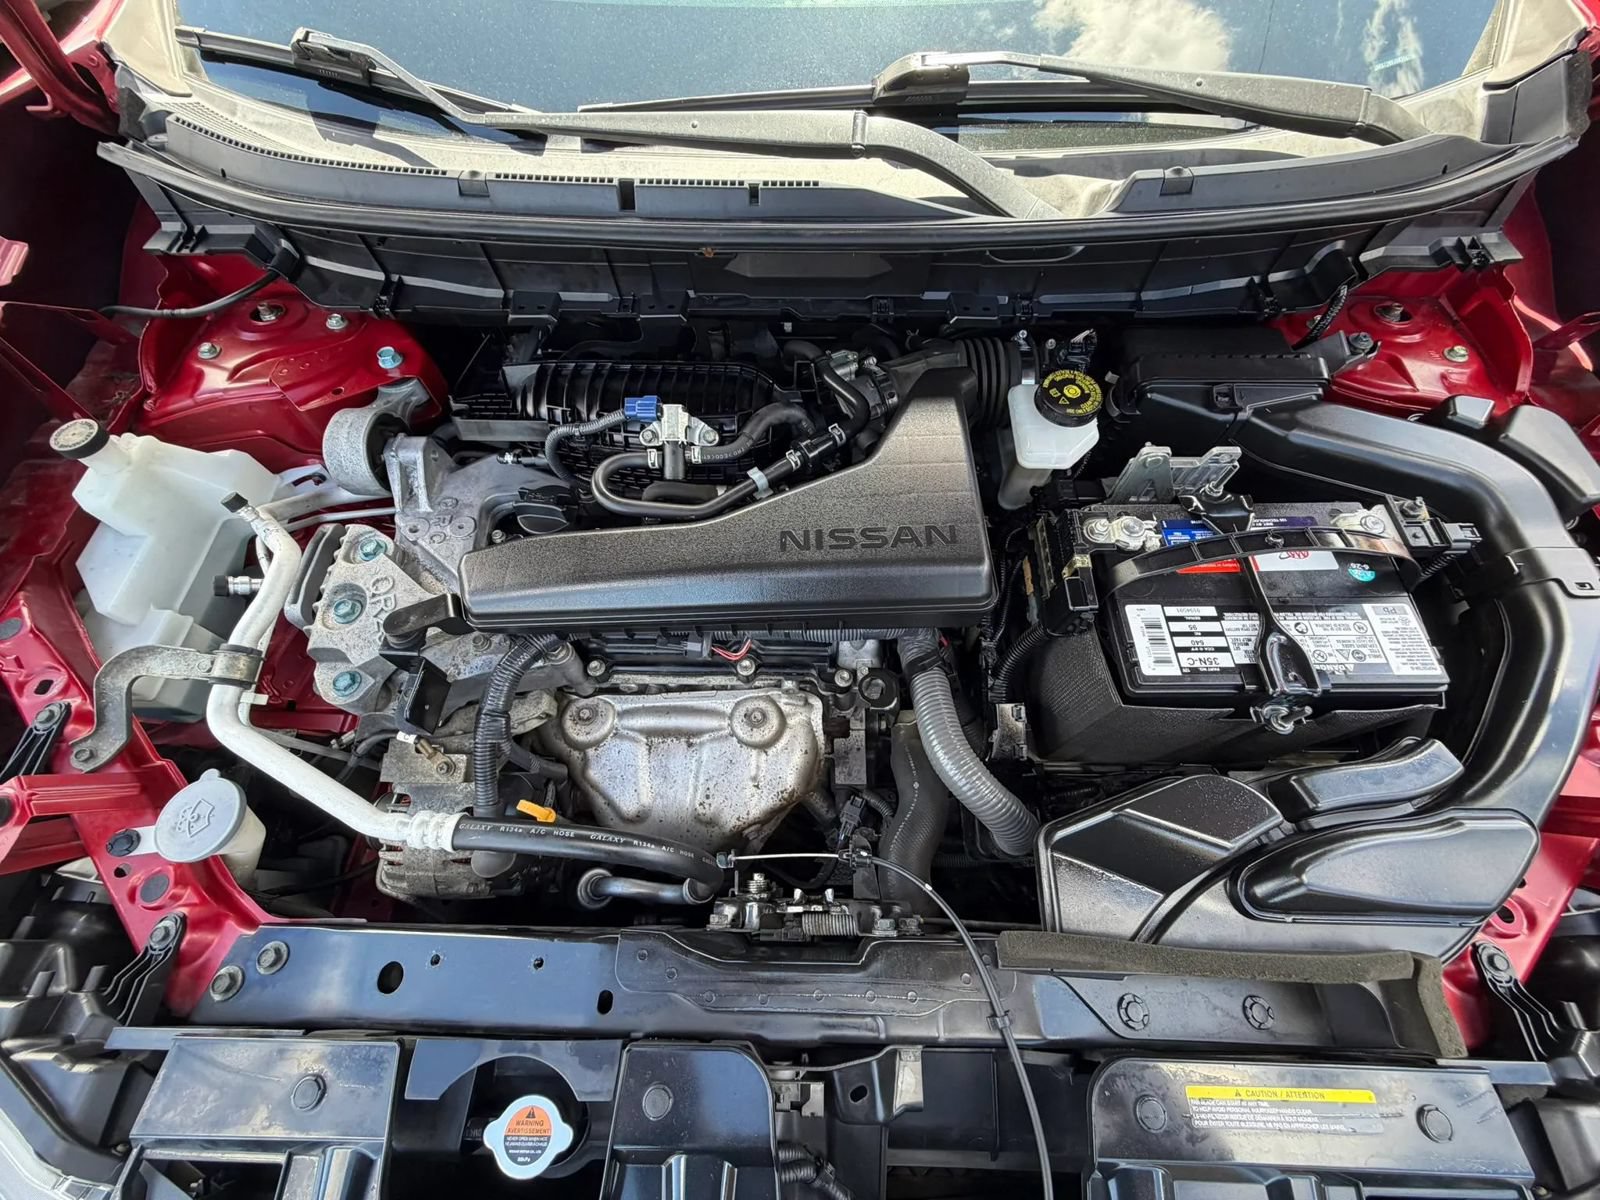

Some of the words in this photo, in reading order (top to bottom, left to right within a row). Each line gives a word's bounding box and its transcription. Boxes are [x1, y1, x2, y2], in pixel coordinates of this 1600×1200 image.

[779, 525, 958, 551] NISSAN
[1186, 657, 1220, 666] 35N-C
[1313, 663, 1347, 672] DANGE
[458, 823, 492, 831] GALAXY
[553, 830, 575, 838] HOSE
[590, 833, 626, 844] GALAXY
[633, 839, 656, 849] R134a
[661, 845, 675, 854] A/C
[1245, 1089, 1278, 1098] CAUTION
[1285, 1090, 1326, 1100] ATTENTION
[515, 1119, 545, 1127] WARNING
[507, 1127, 550, 1135] AVERTISSEMENT
